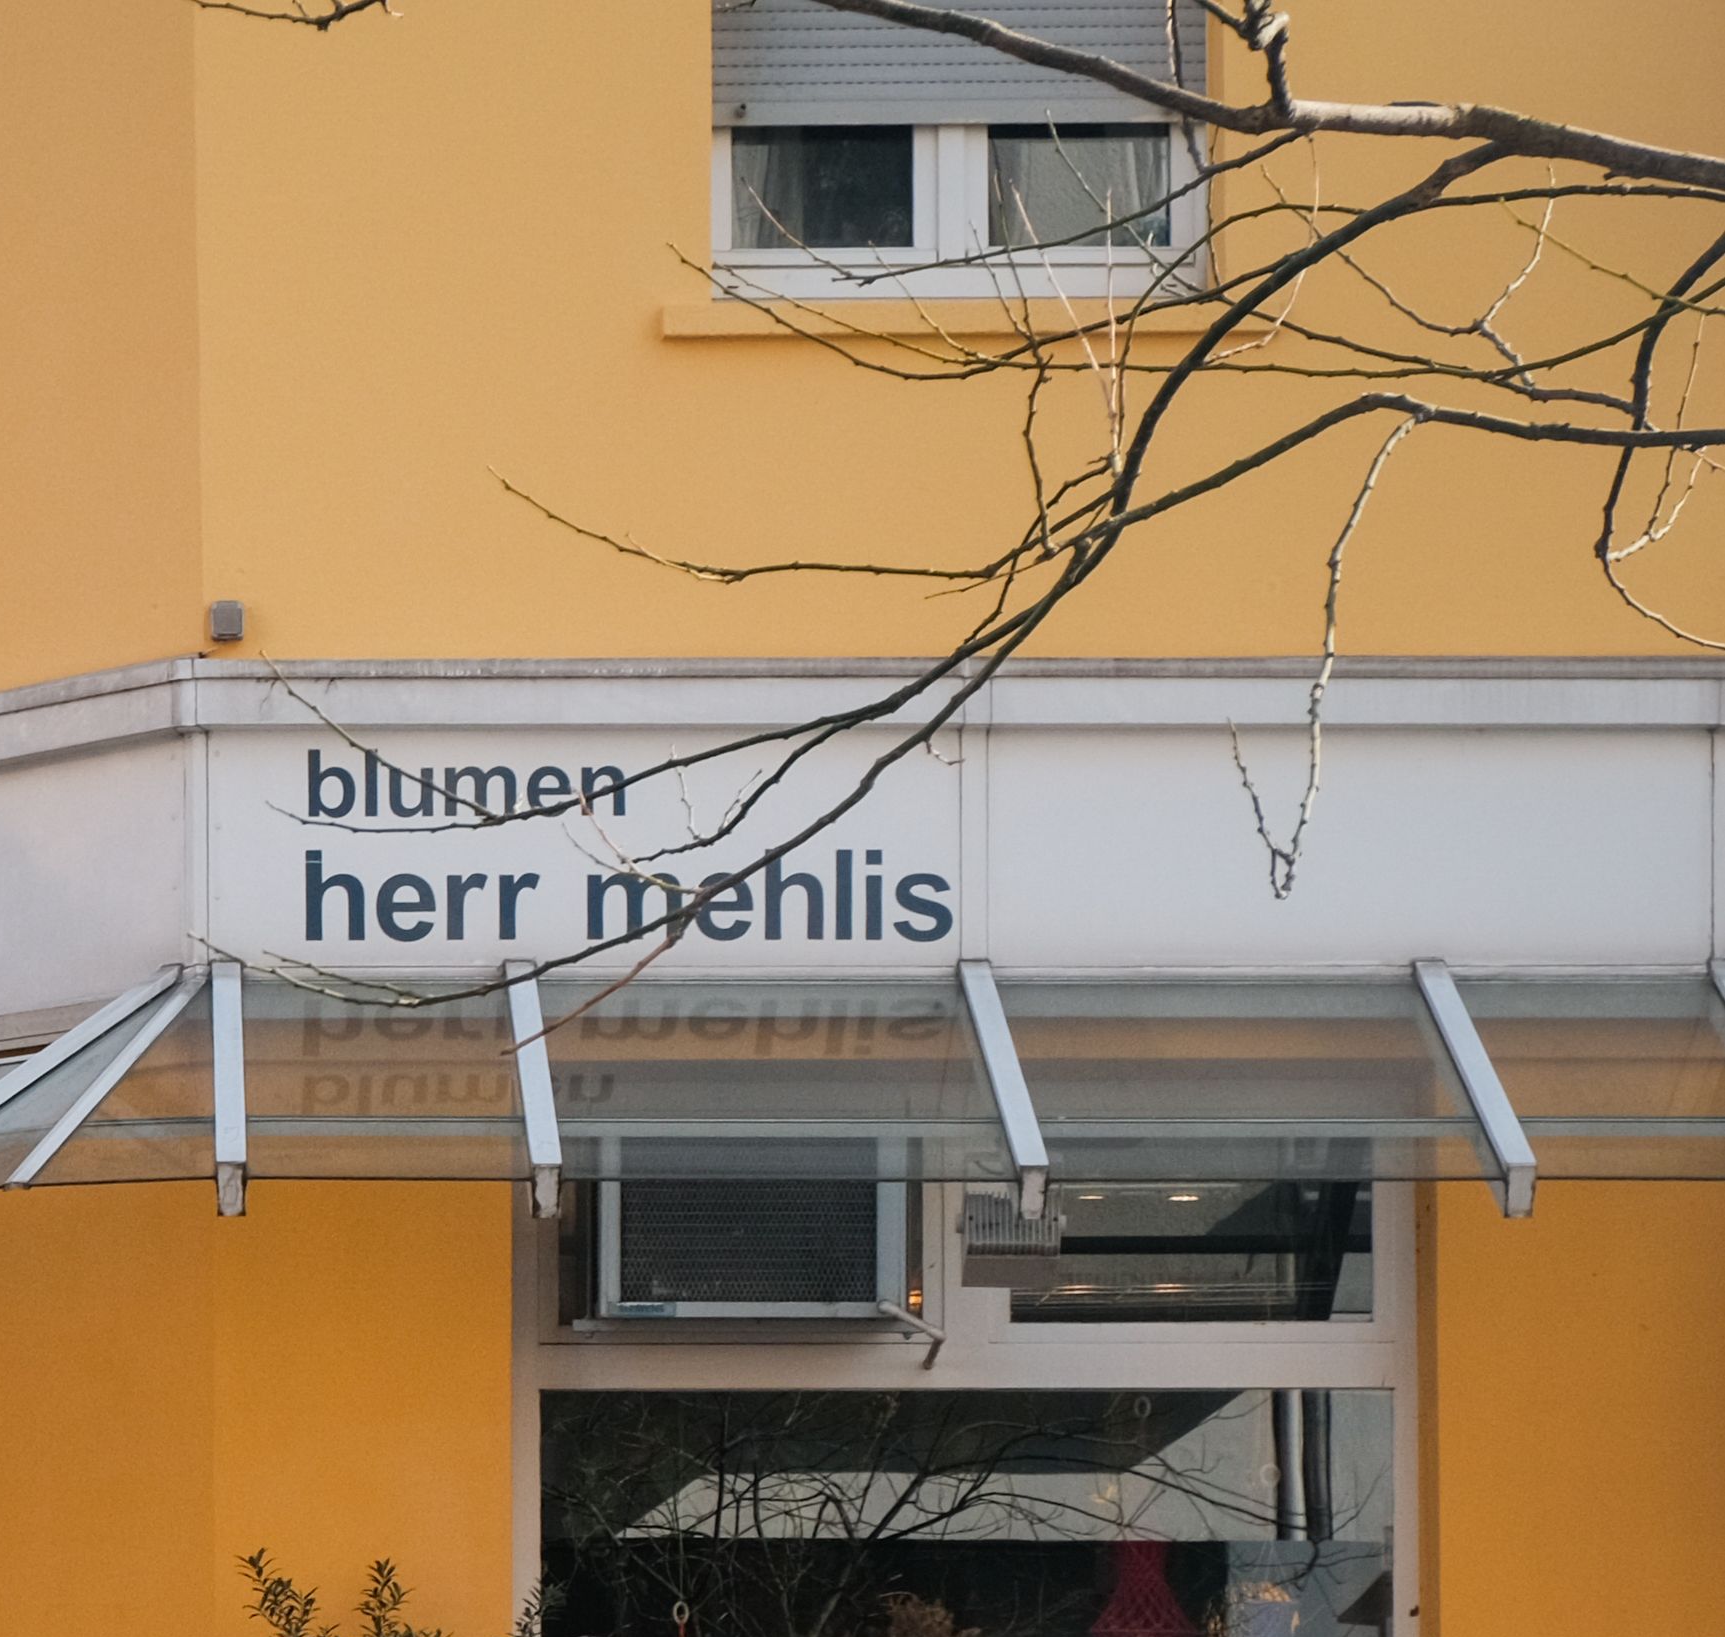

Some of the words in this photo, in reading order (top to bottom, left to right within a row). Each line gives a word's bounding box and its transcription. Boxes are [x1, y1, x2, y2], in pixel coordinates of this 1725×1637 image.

[308, 749, 627, 818] blumen
[305, 849, 540, 942] herr
[587, 849, 954, 942] mehlis
